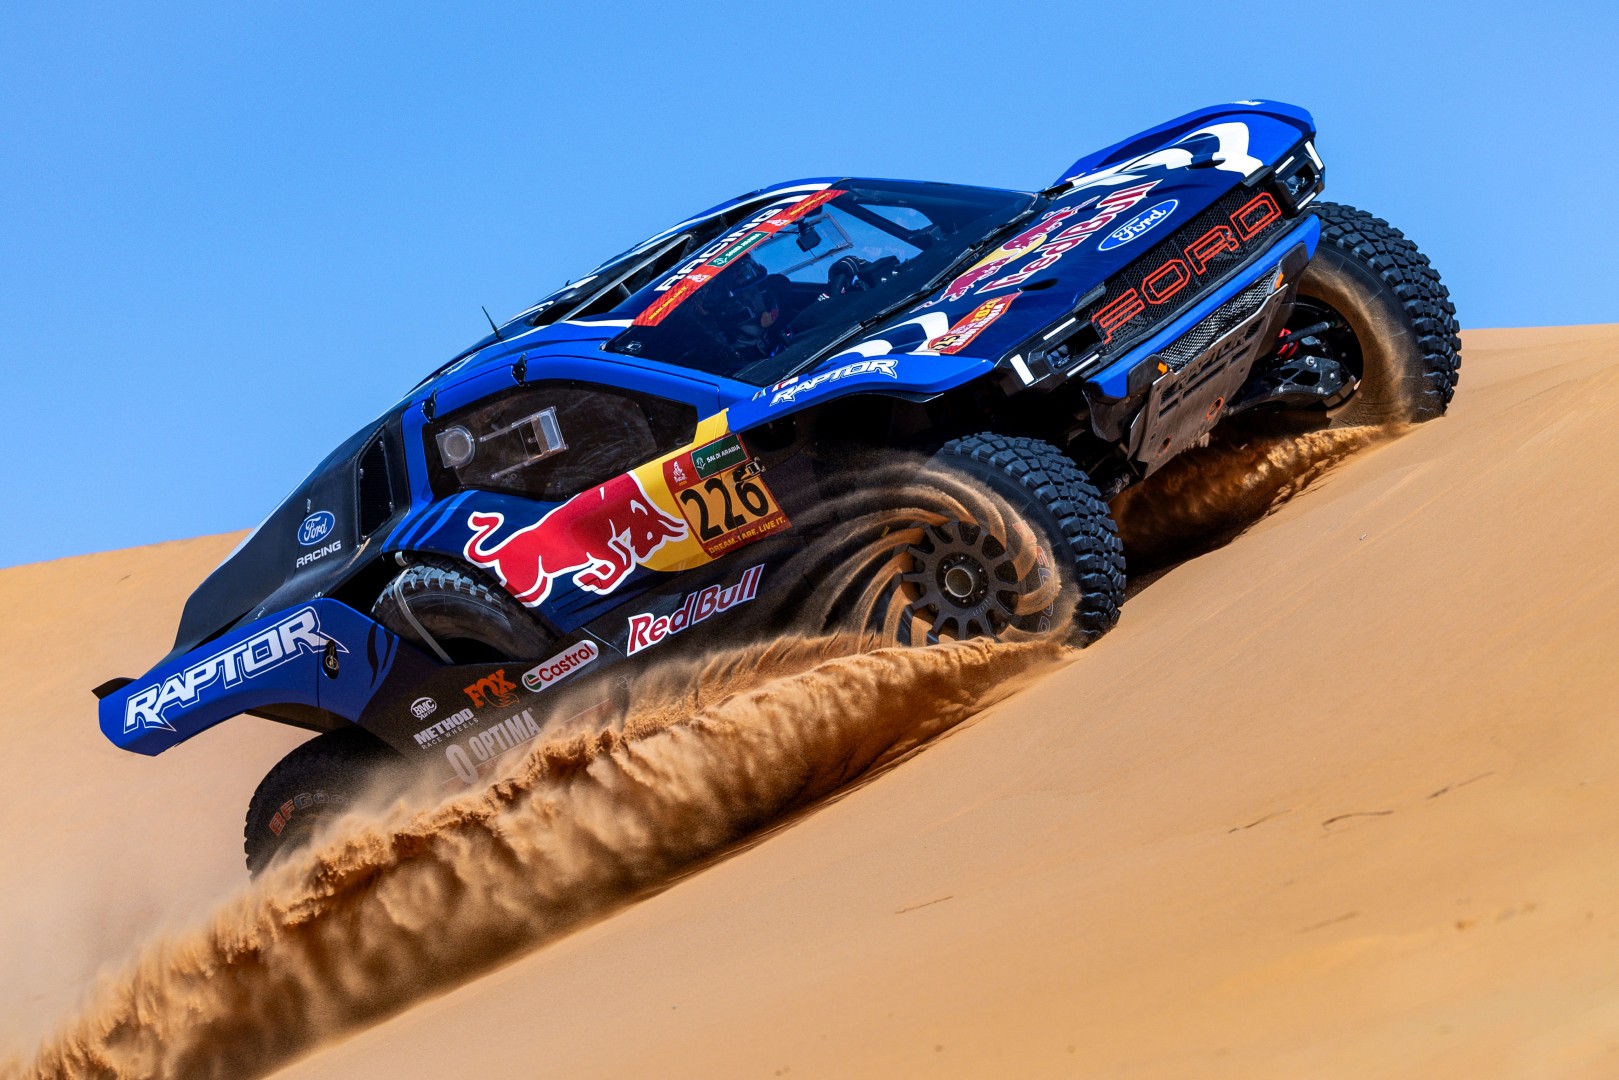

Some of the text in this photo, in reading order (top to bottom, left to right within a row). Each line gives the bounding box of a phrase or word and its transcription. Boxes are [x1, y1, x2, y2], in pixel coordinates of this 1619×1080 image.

[974, 179, 1163, 295] Red Bull
[1112, 207, 1167, 241] Ford
[654, 208, 783, 291] RACING
[1091, 192, 1282, 344] FORD
[769, 359, 899, 406] RAPTOR
[680, 465, 769, 543] 226
[304, 516, 328, 541] Ford
[758, 519, 776, 533] LIVE
[776, 516, 786, 526] IT.
[296, 540, 342, 568] RACING
[627, 564, 765, 657] Red Bull
[124, 606, 349, 734] RAPTOR
[538, 643, 595, 683] Castrol
[412, 699, 435, 716] BMC
[463, 668, 518, 708] FOX
[413, 708, 475, 745] METHOD
[421, 717, 479, 750] RACE WHEELS
[468, 709, 543, 761] OPTIMA
